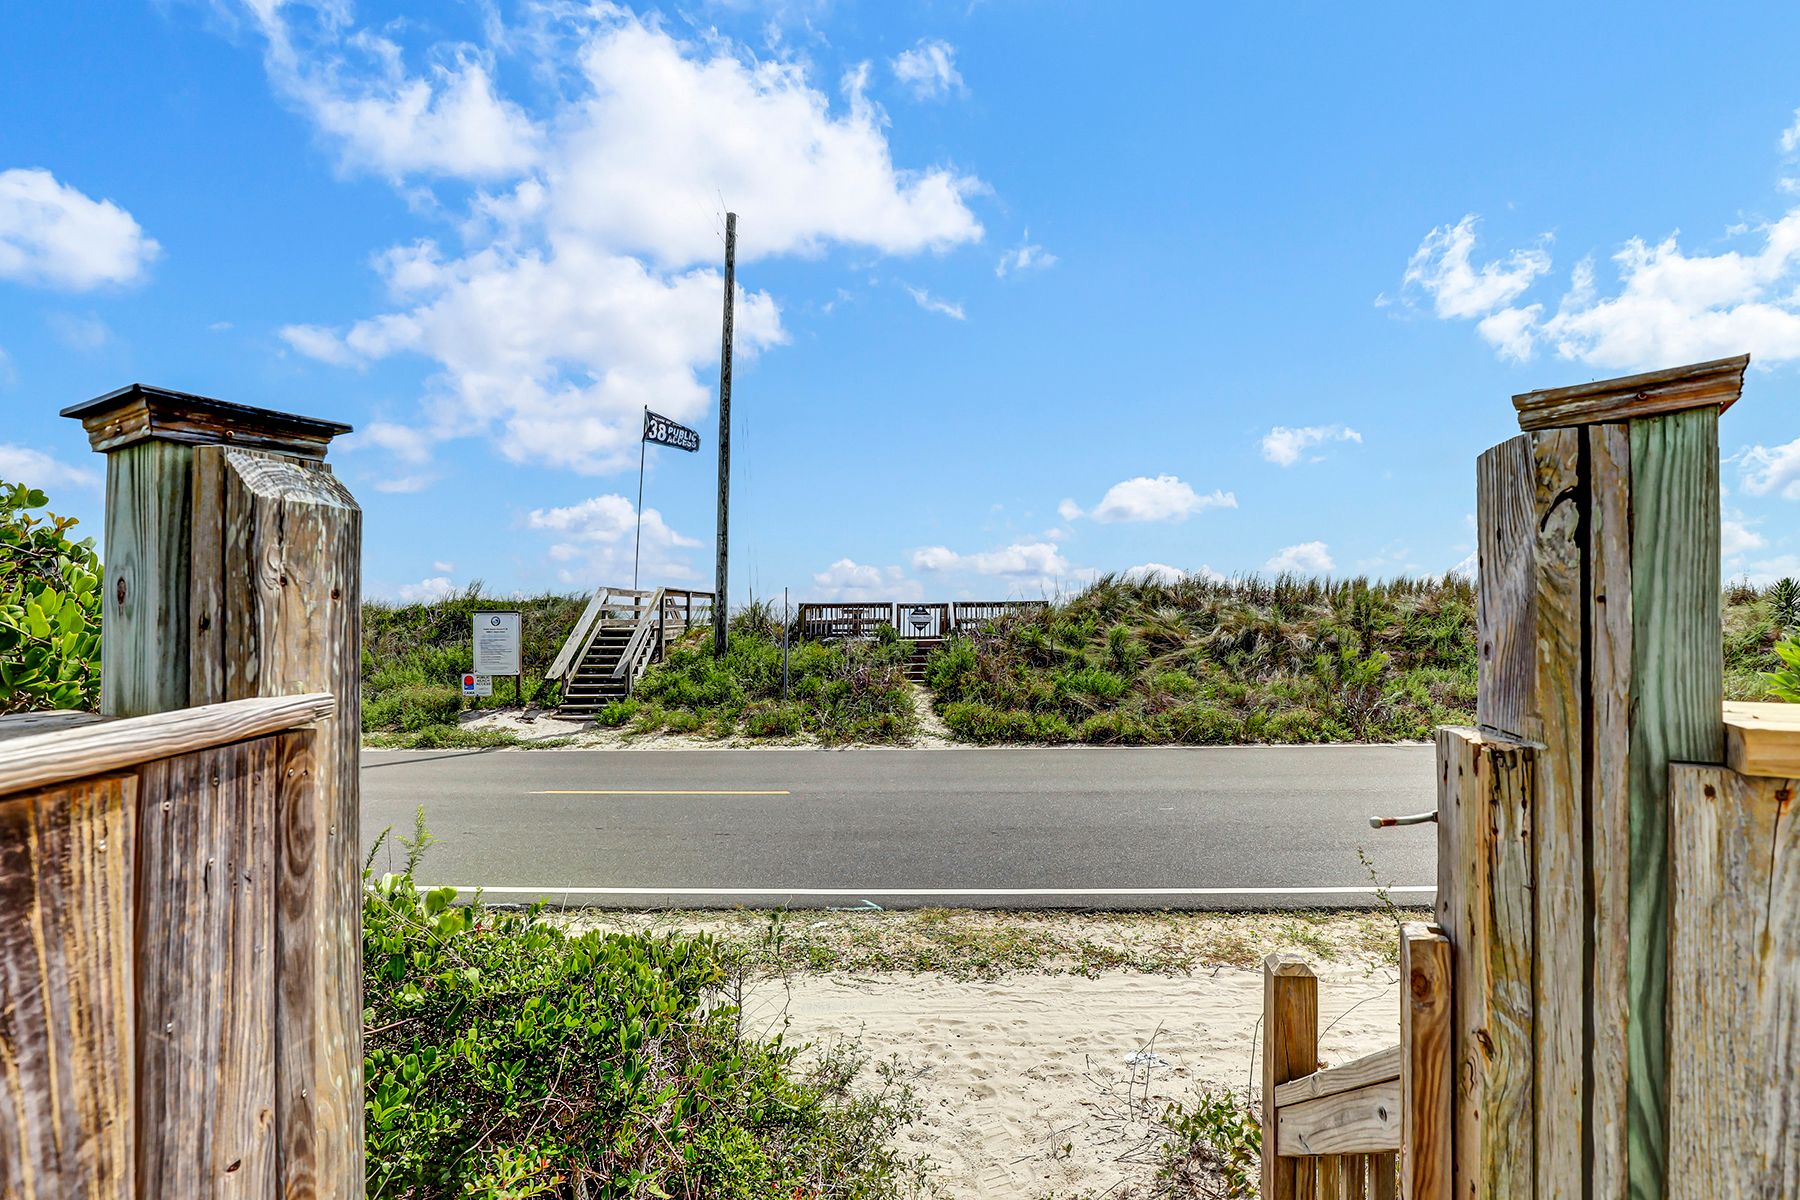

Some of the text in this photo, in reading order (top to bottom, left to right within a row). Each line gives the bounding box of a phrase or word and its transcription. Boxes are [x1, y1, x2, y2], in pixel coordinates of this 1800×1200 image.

[648, 420, 666, 441] 38
[668, 427, 697, 441] PUBLIC
[667, 436, 696, 448] ACCESS
